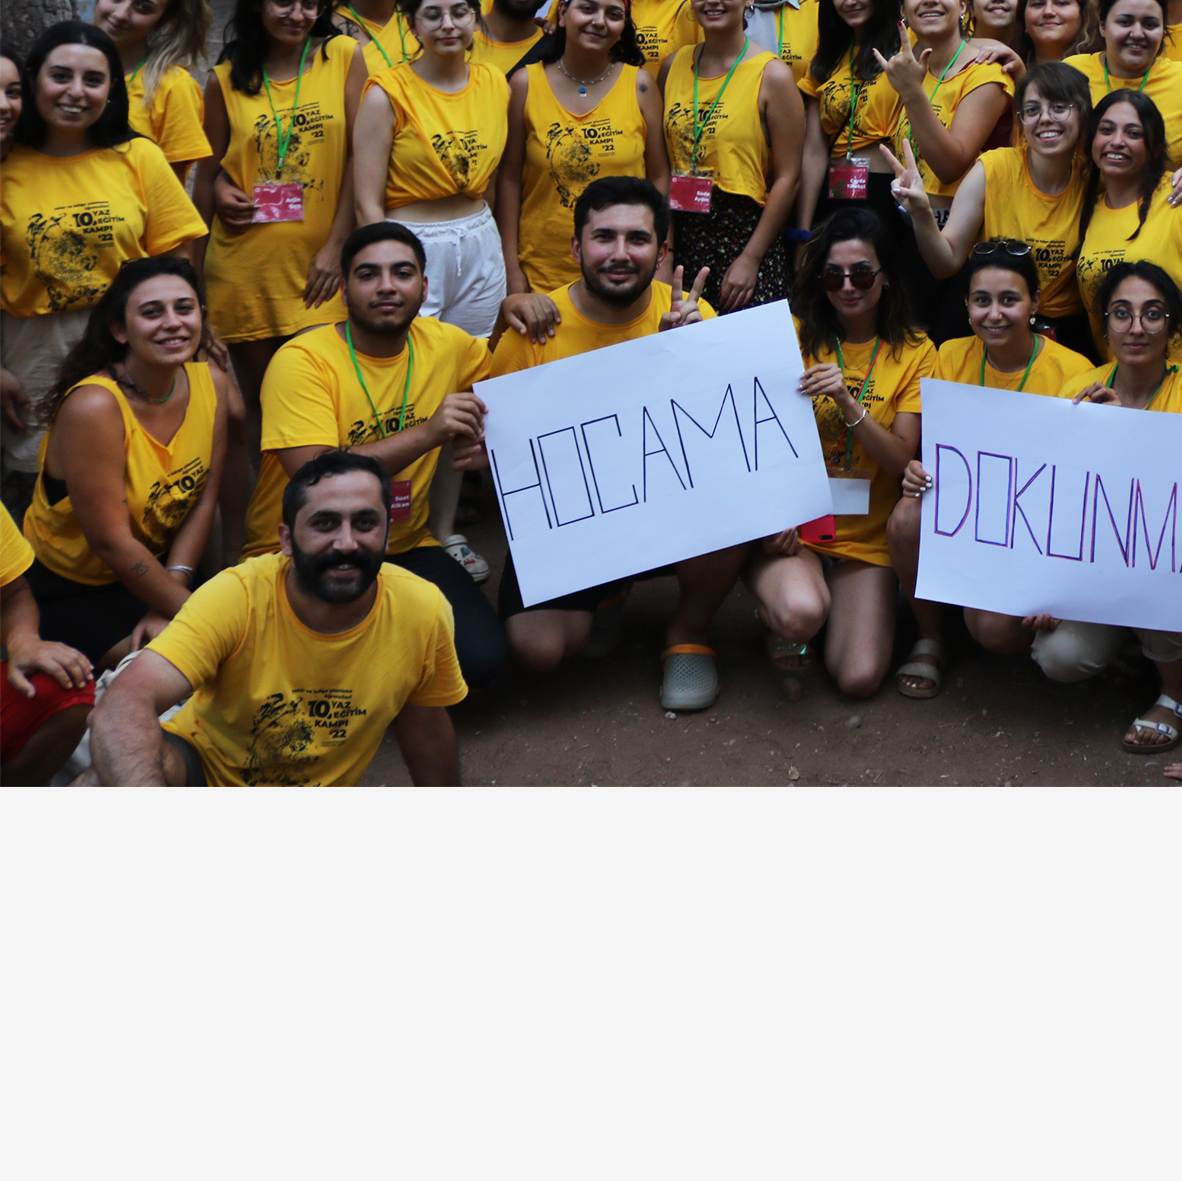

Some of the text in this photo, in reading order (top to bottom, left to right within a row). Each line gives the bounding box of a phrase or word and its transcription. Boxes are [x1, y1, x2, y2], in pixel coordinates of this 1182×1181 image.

[83, 226, 113, 234] KAMPI
[491, 376, 799, 541] HOCAMA
[331, 701, 352, 709] YAZ
[333, 706, 367, 719] EĞİTİM
[314, 719, 349, 728] KAMPI
